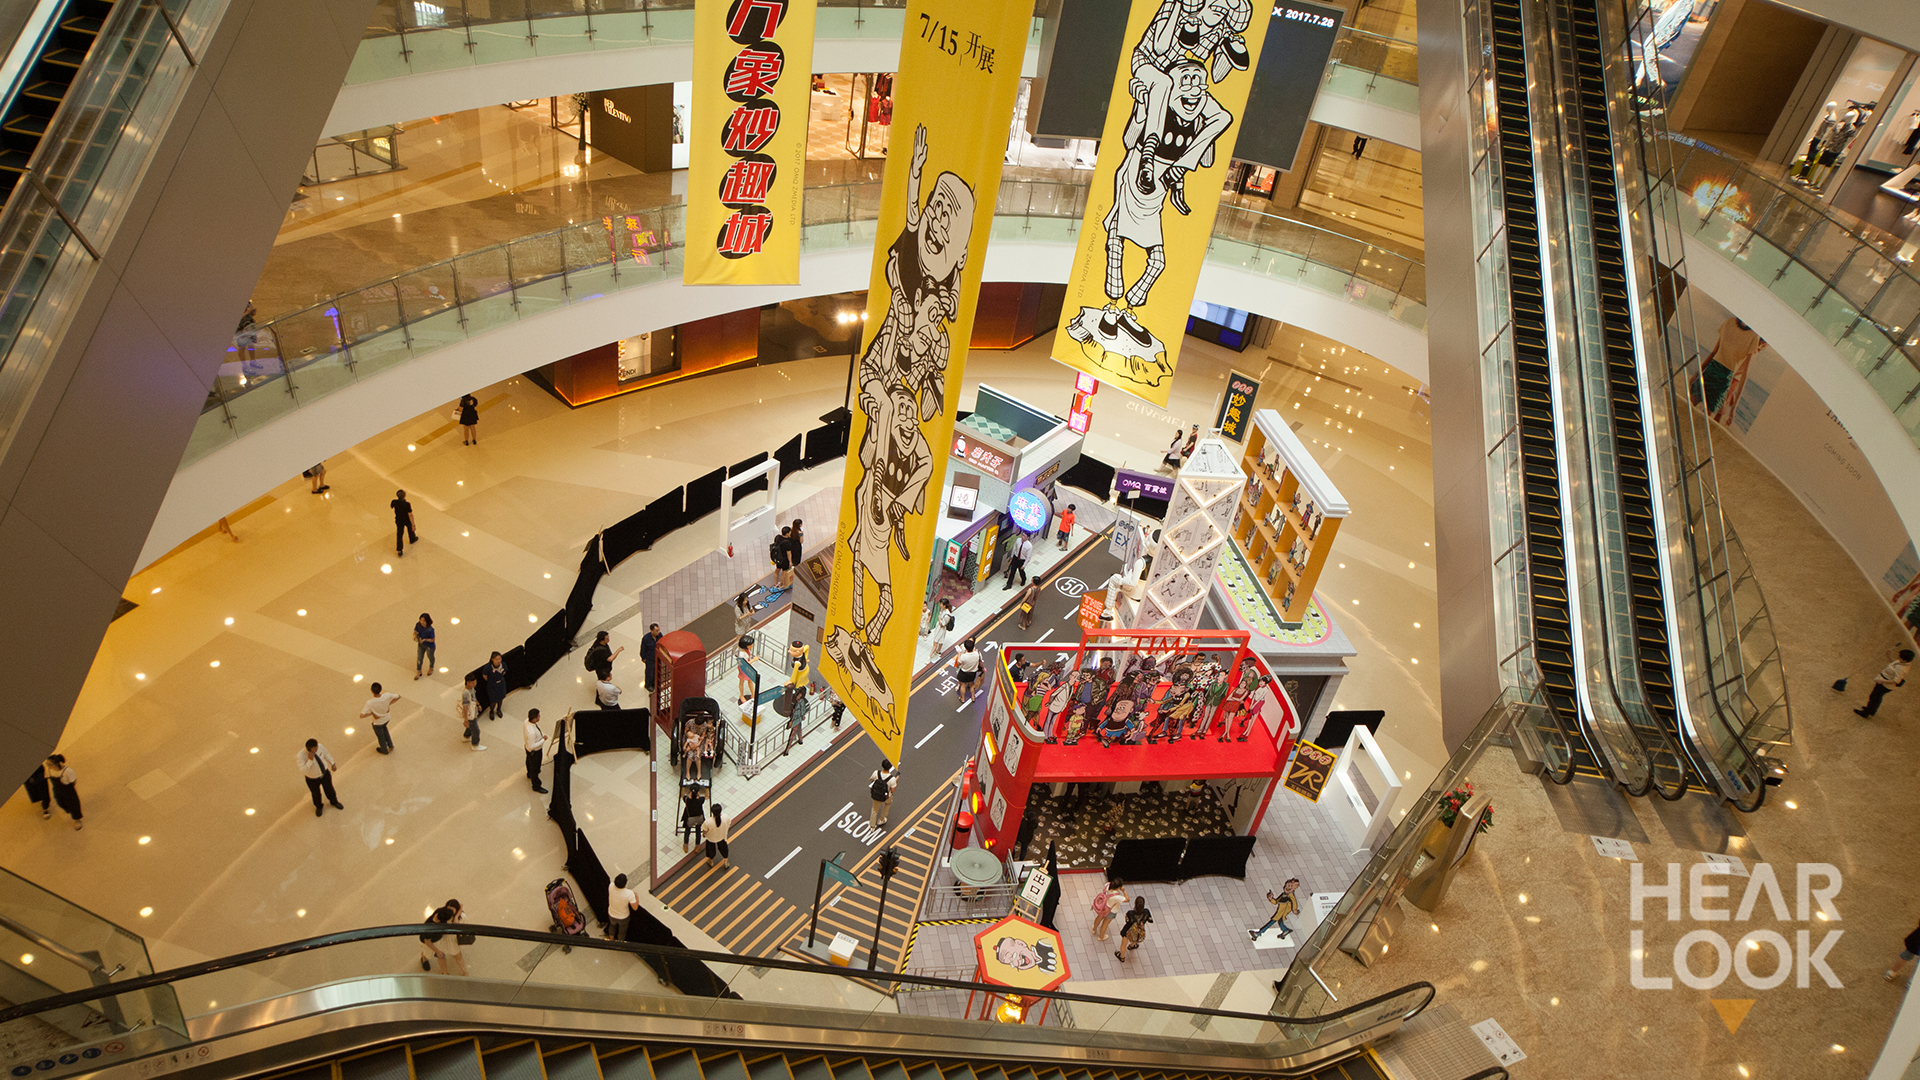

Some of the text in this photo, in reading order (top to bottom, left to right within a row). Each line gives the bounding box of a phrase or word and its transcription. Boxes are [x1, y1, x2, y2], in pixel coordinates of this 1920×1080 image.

[1285, 9, 1335, 28] 2017.7.28
[920, 12, 995, 74] 7/15 开展
[790, 186, 798, 212] ZMEDIA
[1093, 212, 1101, 231] 2017
[1087, 232, 1097, 253] OMQ
[1081, 254, 1092, 283] ZMEDIA
[1223, 393, 1246, 436] 妙趣城
[970, 446, 1004, 468] 老夫子
[1824, 442, 1862, 481] COMING SOON
[1122, 479, 1142, 490] OMQ
[838, 529, 846, 549] 2017
[835, 550, 843, 571] OMQ
[832, 571, 840, 600] ZMEDIA
[1060, 579, 1084, 595] 50
[1083, 594, 1104, 610] THE
[1080, 608, 1100, 622] CITY
[1130, 636, 1203, 656] TIME
[1290, 761, 1325, 793] VR
[836, 811, 887, 846] SLOW
[1030, 873, 1046, 896] 出口
